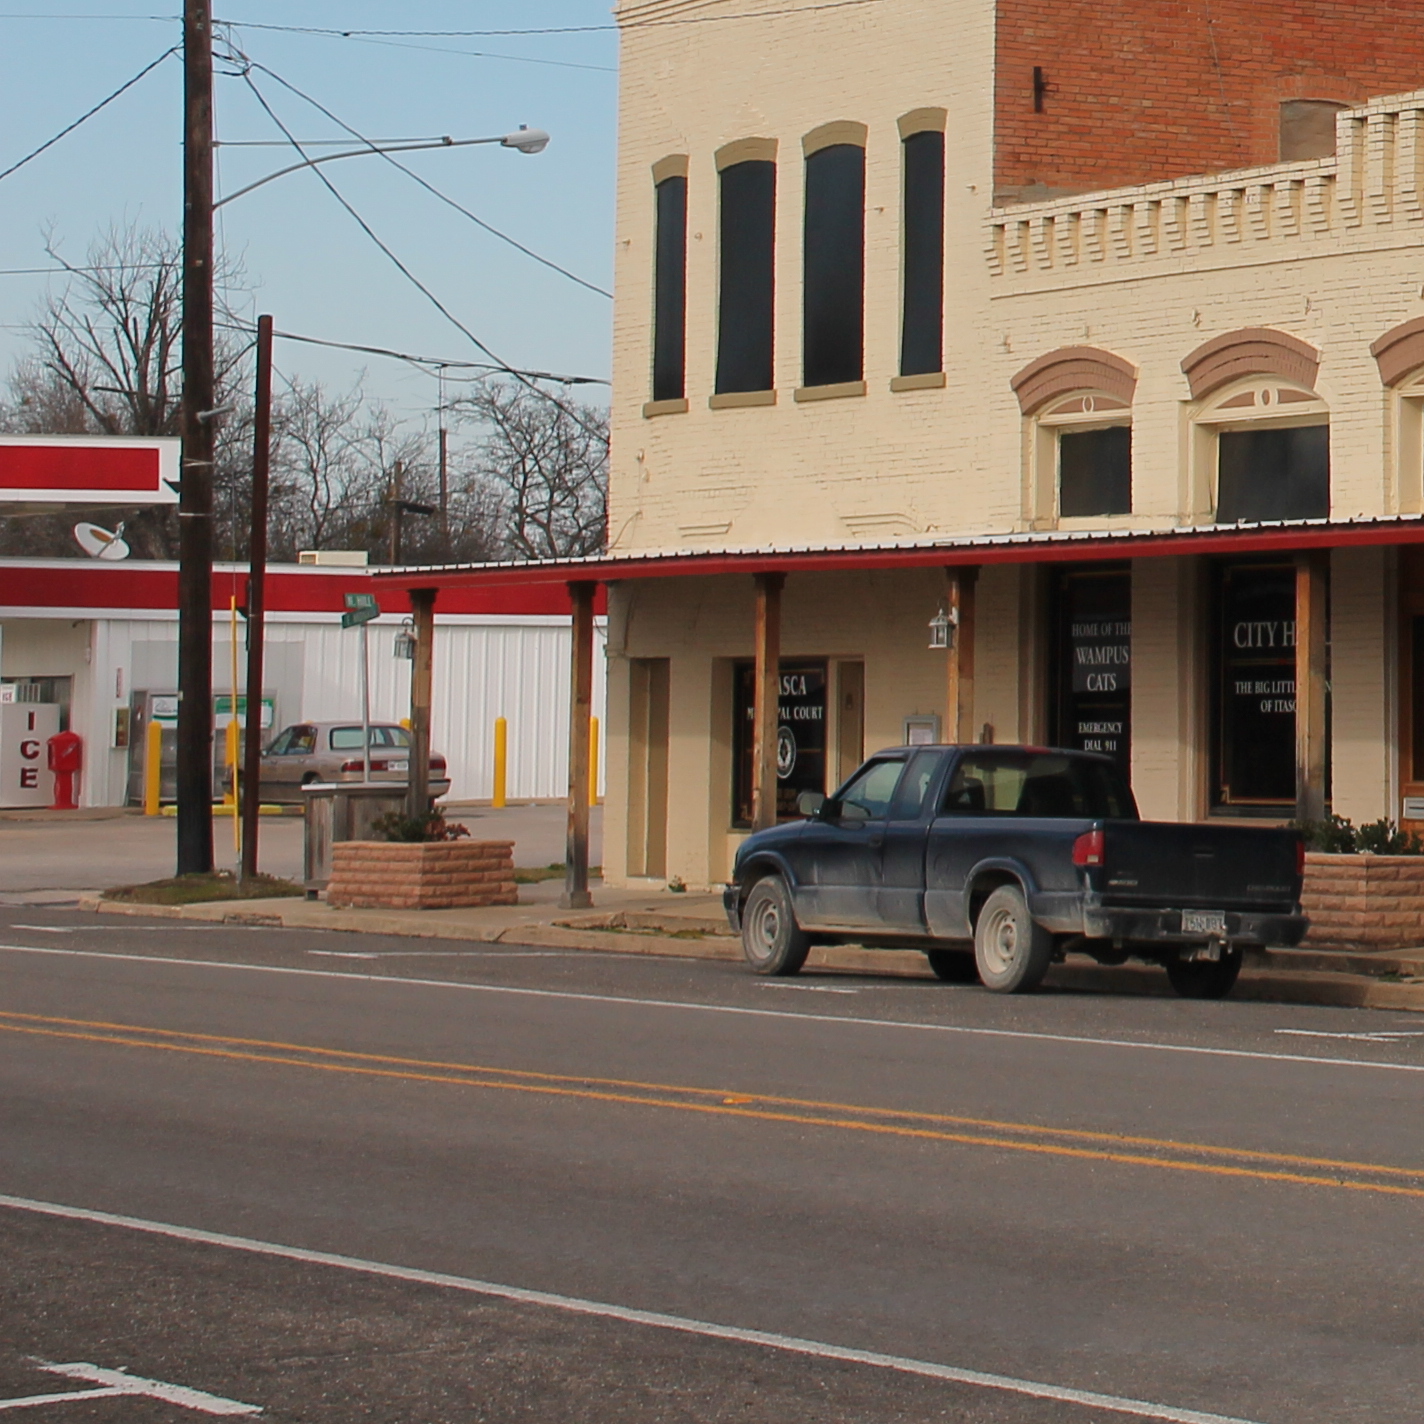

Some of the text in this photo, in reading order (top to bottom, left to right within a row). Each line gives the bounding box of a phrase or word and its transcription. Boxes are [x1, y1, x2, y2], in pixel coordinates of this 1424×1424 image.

[1072, 623, 1099, 637] HOME
[1101, 622, 1113, 636] OF
[1234, 621, 1278, 648] CITY
[1076, 645, 1130, 665] WAMPUS
[1087, 673, 1117, 692] CATS
[1235, 681, 1253, 694] THE
[1255, 681, 1270, 694] BIG
[794, 706, 823, 719] COURT
[1260, 700, 1273, 713] OF
[1078, 721, 1123, 734] EMERGENCY
[20, 711, 40, 789] ICE
[1084, 739, 1117, 751] DIAL 911
